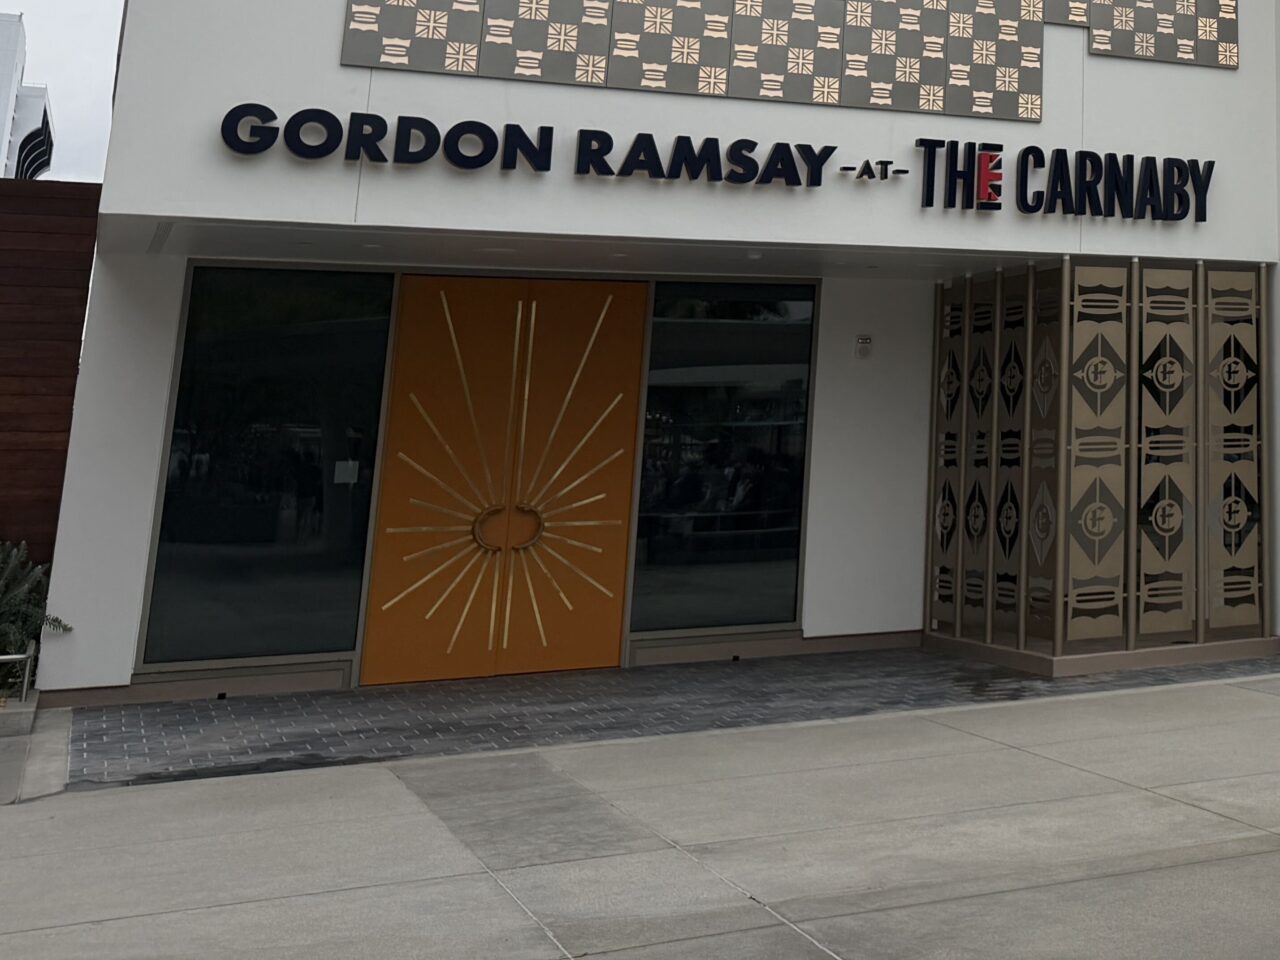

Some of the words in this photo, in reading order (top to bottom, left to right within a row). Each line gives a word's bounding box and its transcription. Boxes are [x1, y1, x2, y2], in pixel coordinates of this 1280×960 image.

[221, 103, 554, 172] GORDON
[574, 129, 837, 187] RAMSAY
[915, 138, 1003, 210] THE
[1016, 145, 1215, 222] CARNABY
